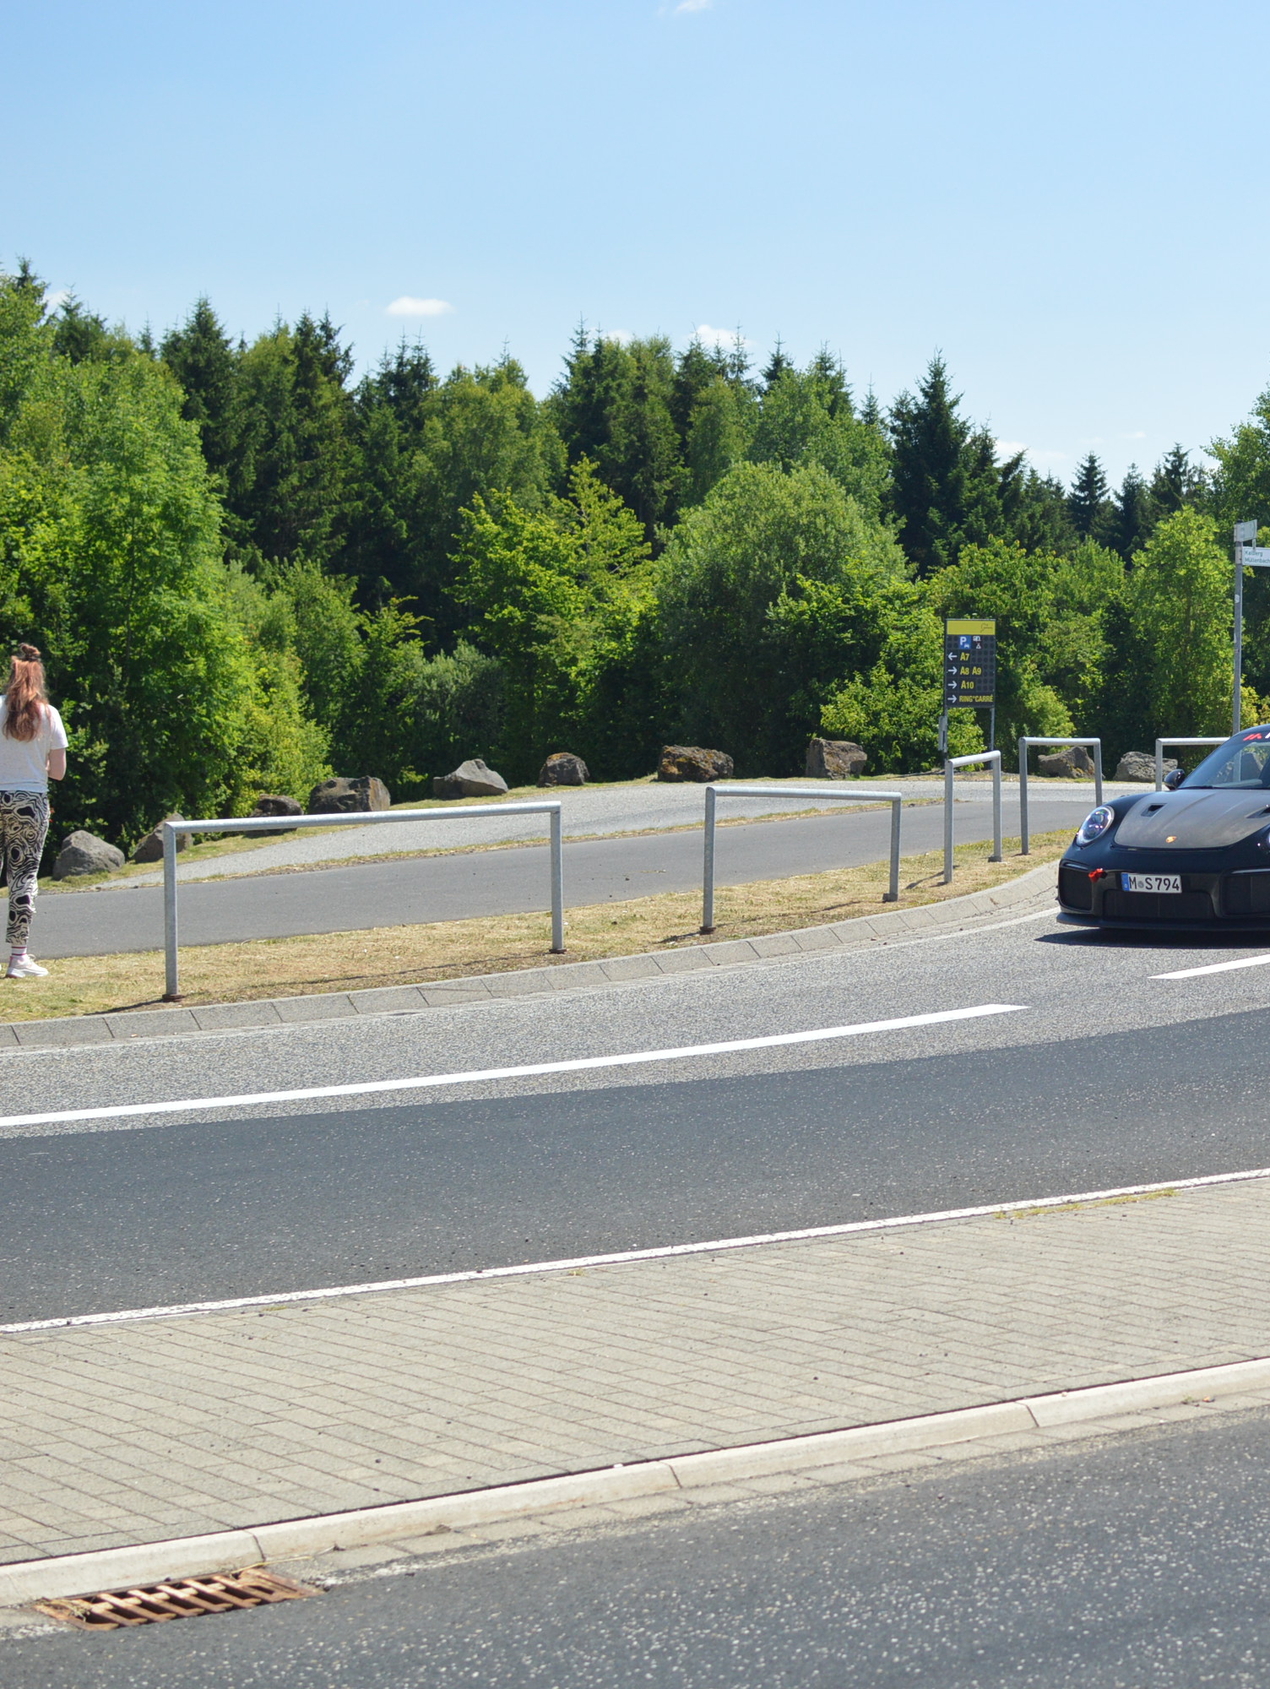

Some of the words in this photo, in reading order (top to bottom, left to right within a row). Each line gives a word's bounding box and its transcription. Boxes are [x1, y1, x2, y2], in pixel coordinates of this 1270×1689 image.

[959, 636, 967, 646] P
[959, 652, 970, 661] A7
[959, 666, 970, 675] A8
[971, 666, 982, 675] A9
[960, 680, 975, 689] A10
